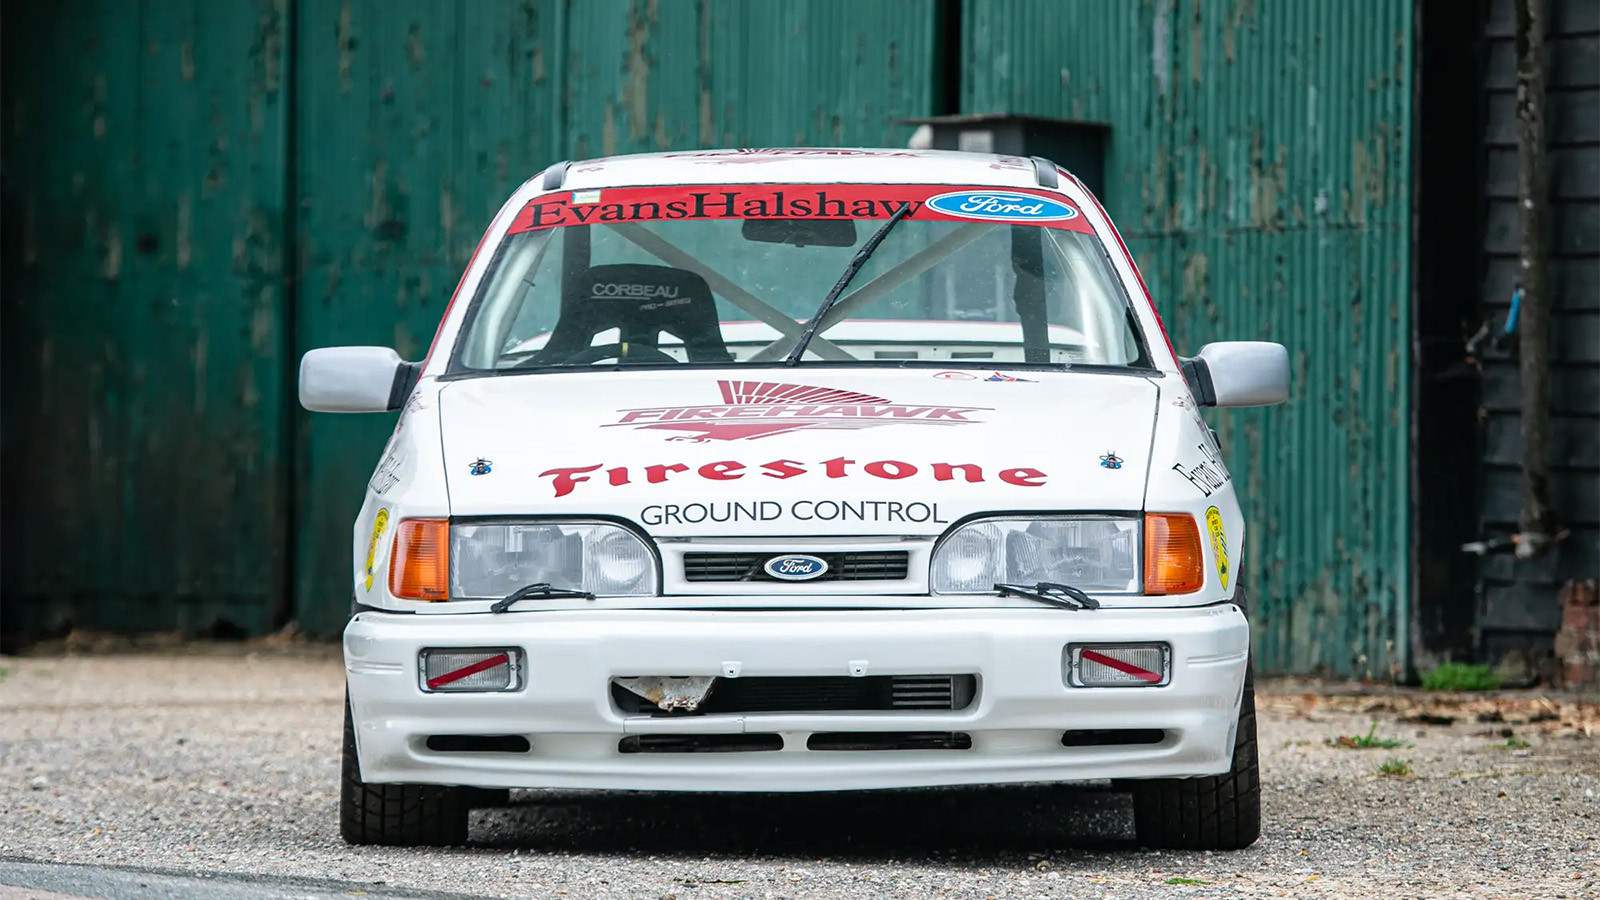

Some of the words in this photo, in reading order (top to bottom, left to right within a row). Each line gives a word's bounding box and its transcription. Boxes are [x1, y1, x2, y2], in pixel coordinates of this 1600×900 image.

[960, 195, 1043, 215] Ford
[591, 283, 678, 298] CORBEAU
[618, 405, 980, 423] FIREHAWK
[537, 456, 1047, 498] Firestone
[640, 501, 783, 526] GROUND
[791, 500, 949, 525] CONTROL
[779, 559, 813, 573] Ford
